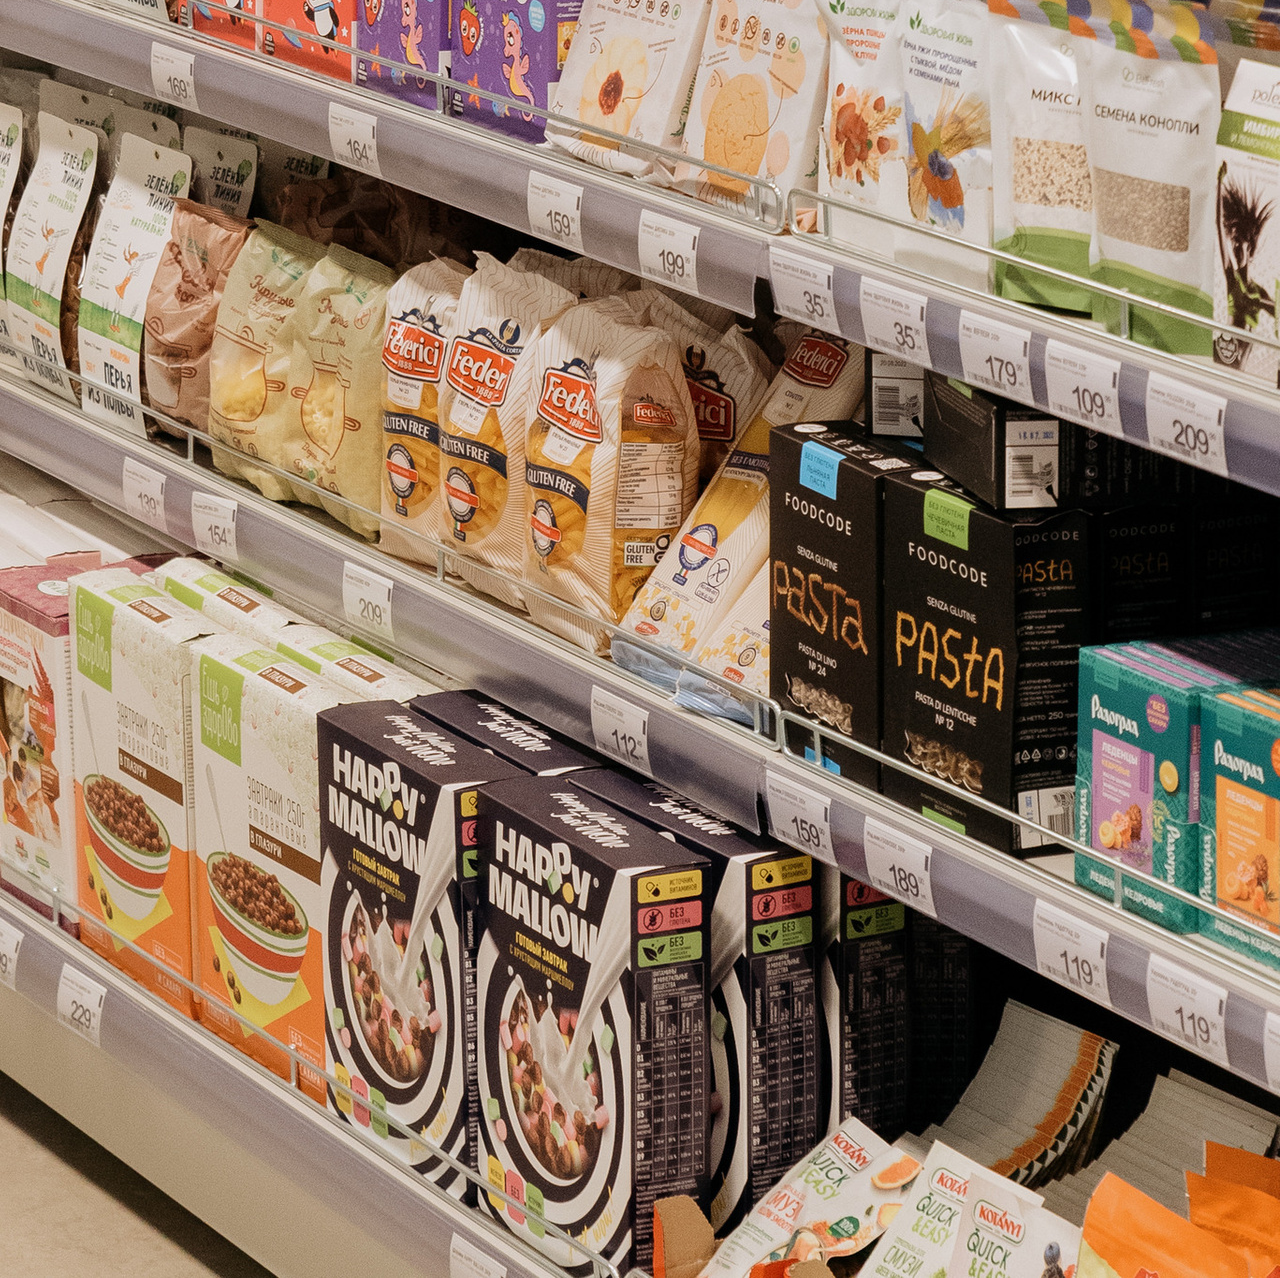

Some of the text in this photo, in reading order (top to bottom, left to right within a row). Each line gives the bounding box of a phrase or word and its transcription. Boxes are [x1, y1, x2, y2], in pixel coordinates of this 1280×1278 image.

[1095, 104, 1200, 136] СЕМЕНА КОНОПЛИ
[785, 492, 851, 536] FOODCODE
[626, 543, 655, 555] GLUTEN
[626, 554, 645, 563] FREE
[909, 542, 987, 587] FOODCODE
[332, 742, 419, 827] HAPPY
[328, 785, 428, 877] MALLOW
[495, 820, 592, 912] HAPPY
[489, 864, 599, 962] MALLOW
